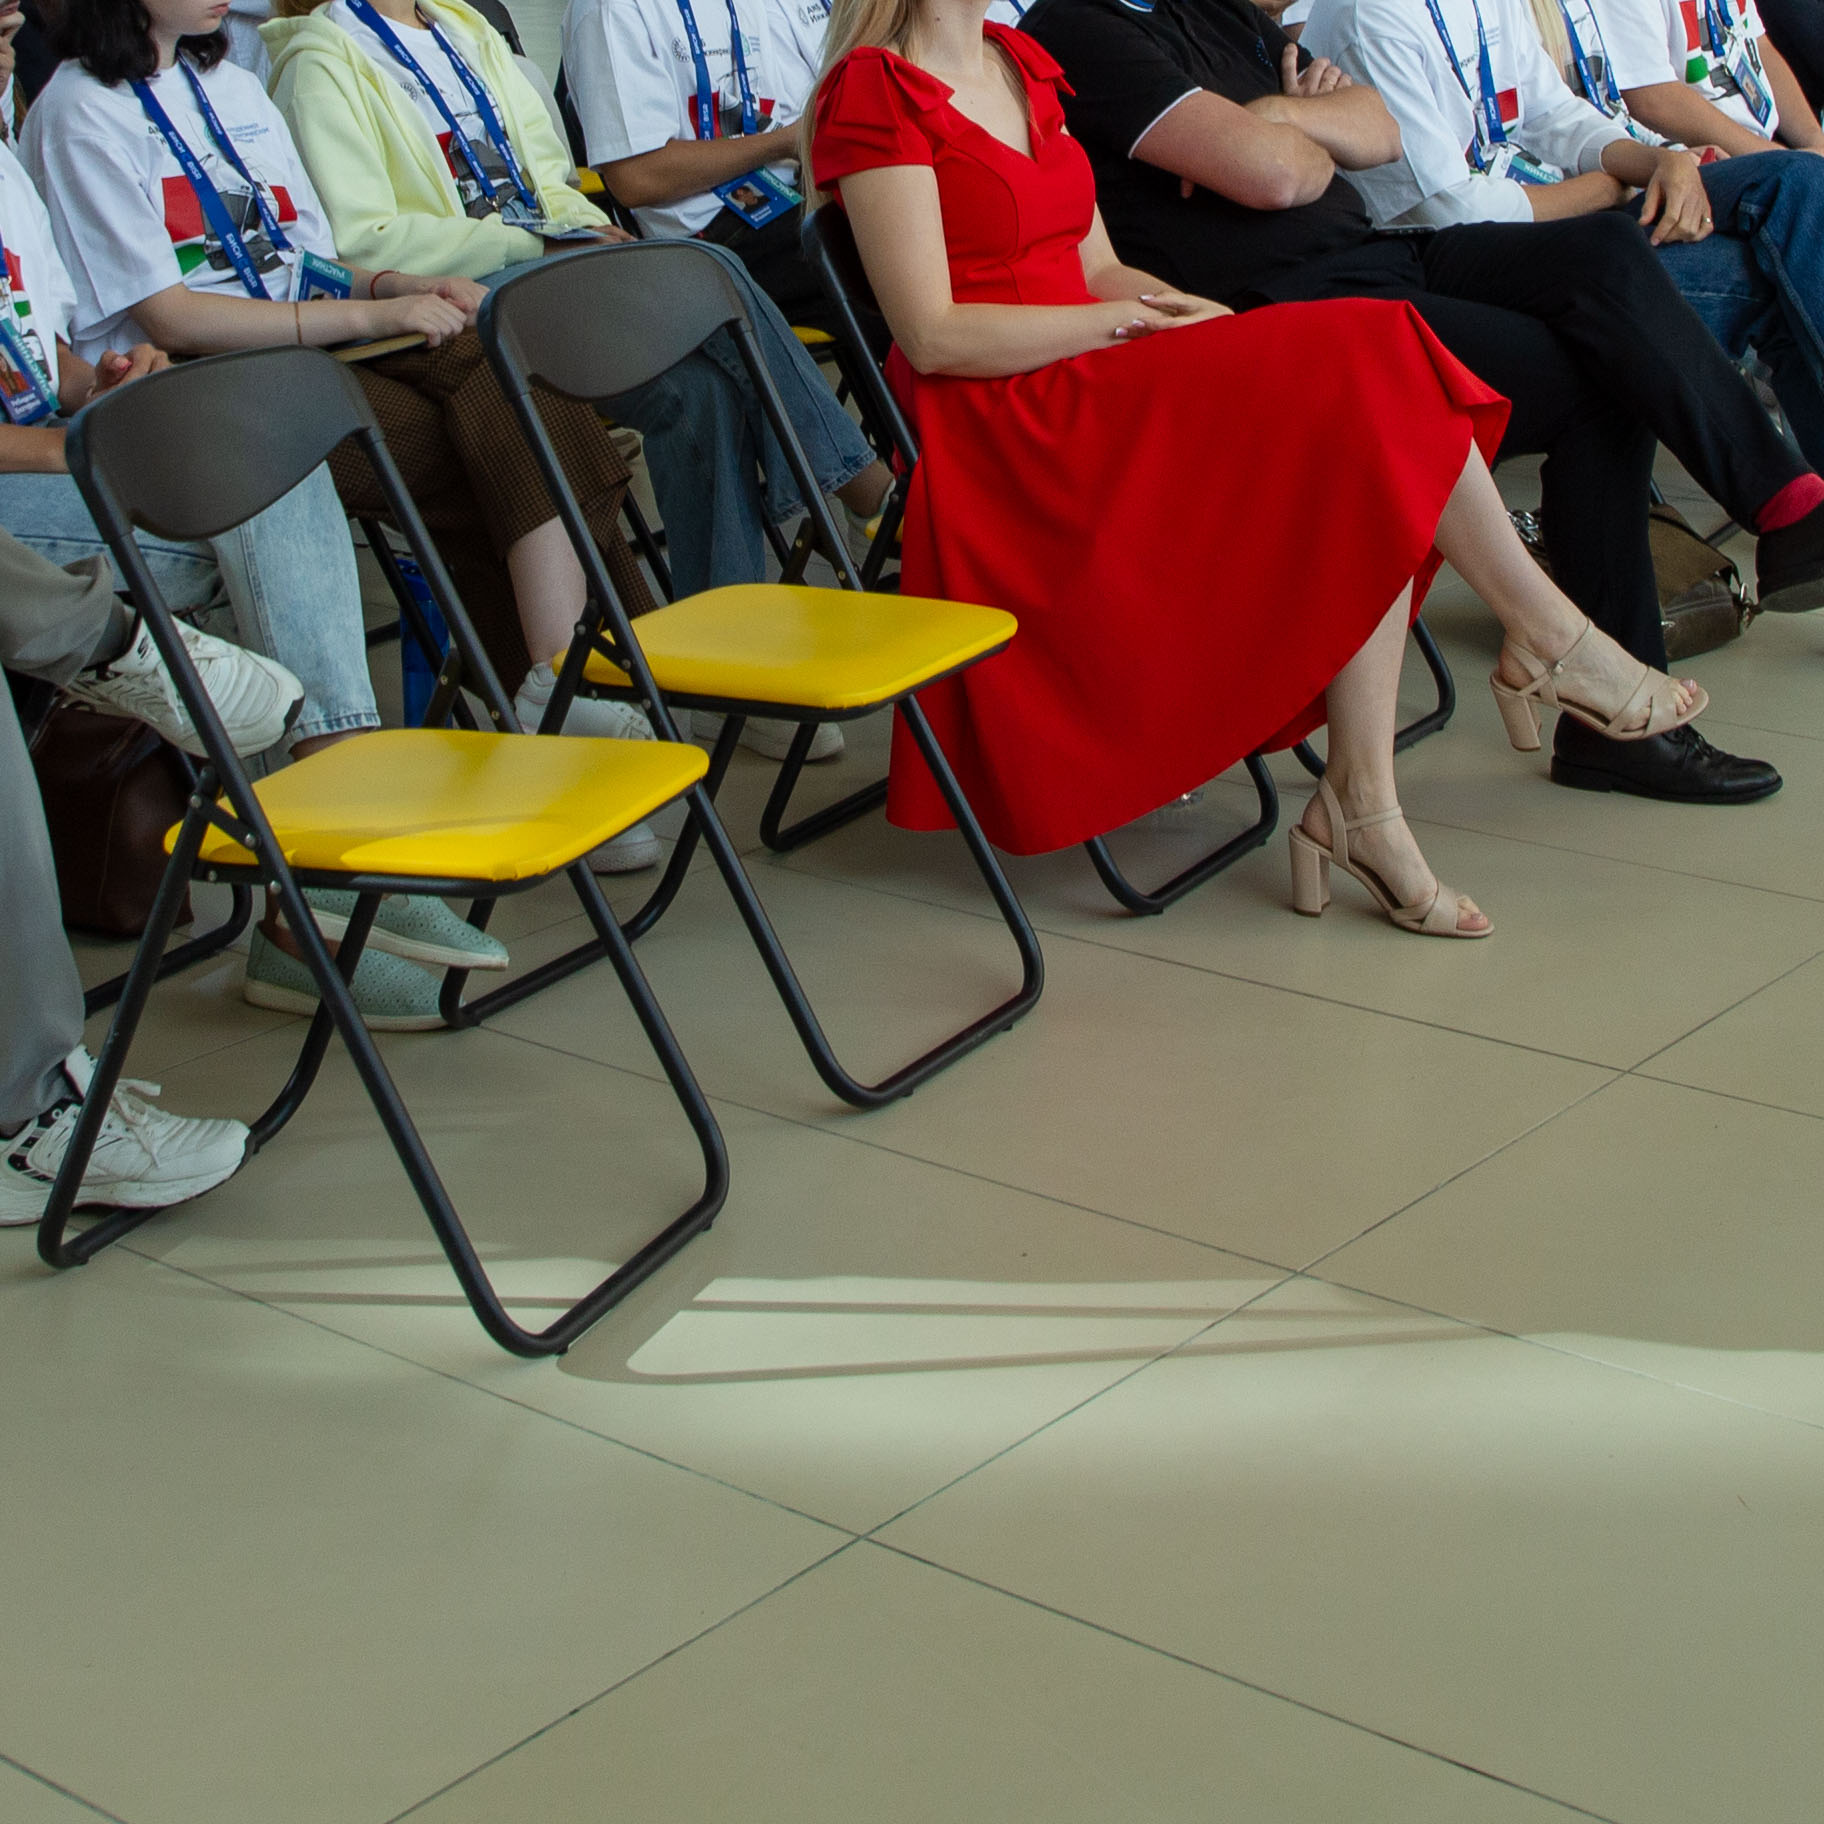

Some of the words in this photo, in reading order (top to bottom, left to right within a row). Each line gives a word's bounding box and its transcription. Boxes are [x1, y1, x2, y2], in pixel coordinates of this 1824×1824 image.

[226, 233, 243, 259] БИСИ
[243, 267, 258, 288] BISR
[311, 257, 346, 279] УЧАСТНИК
